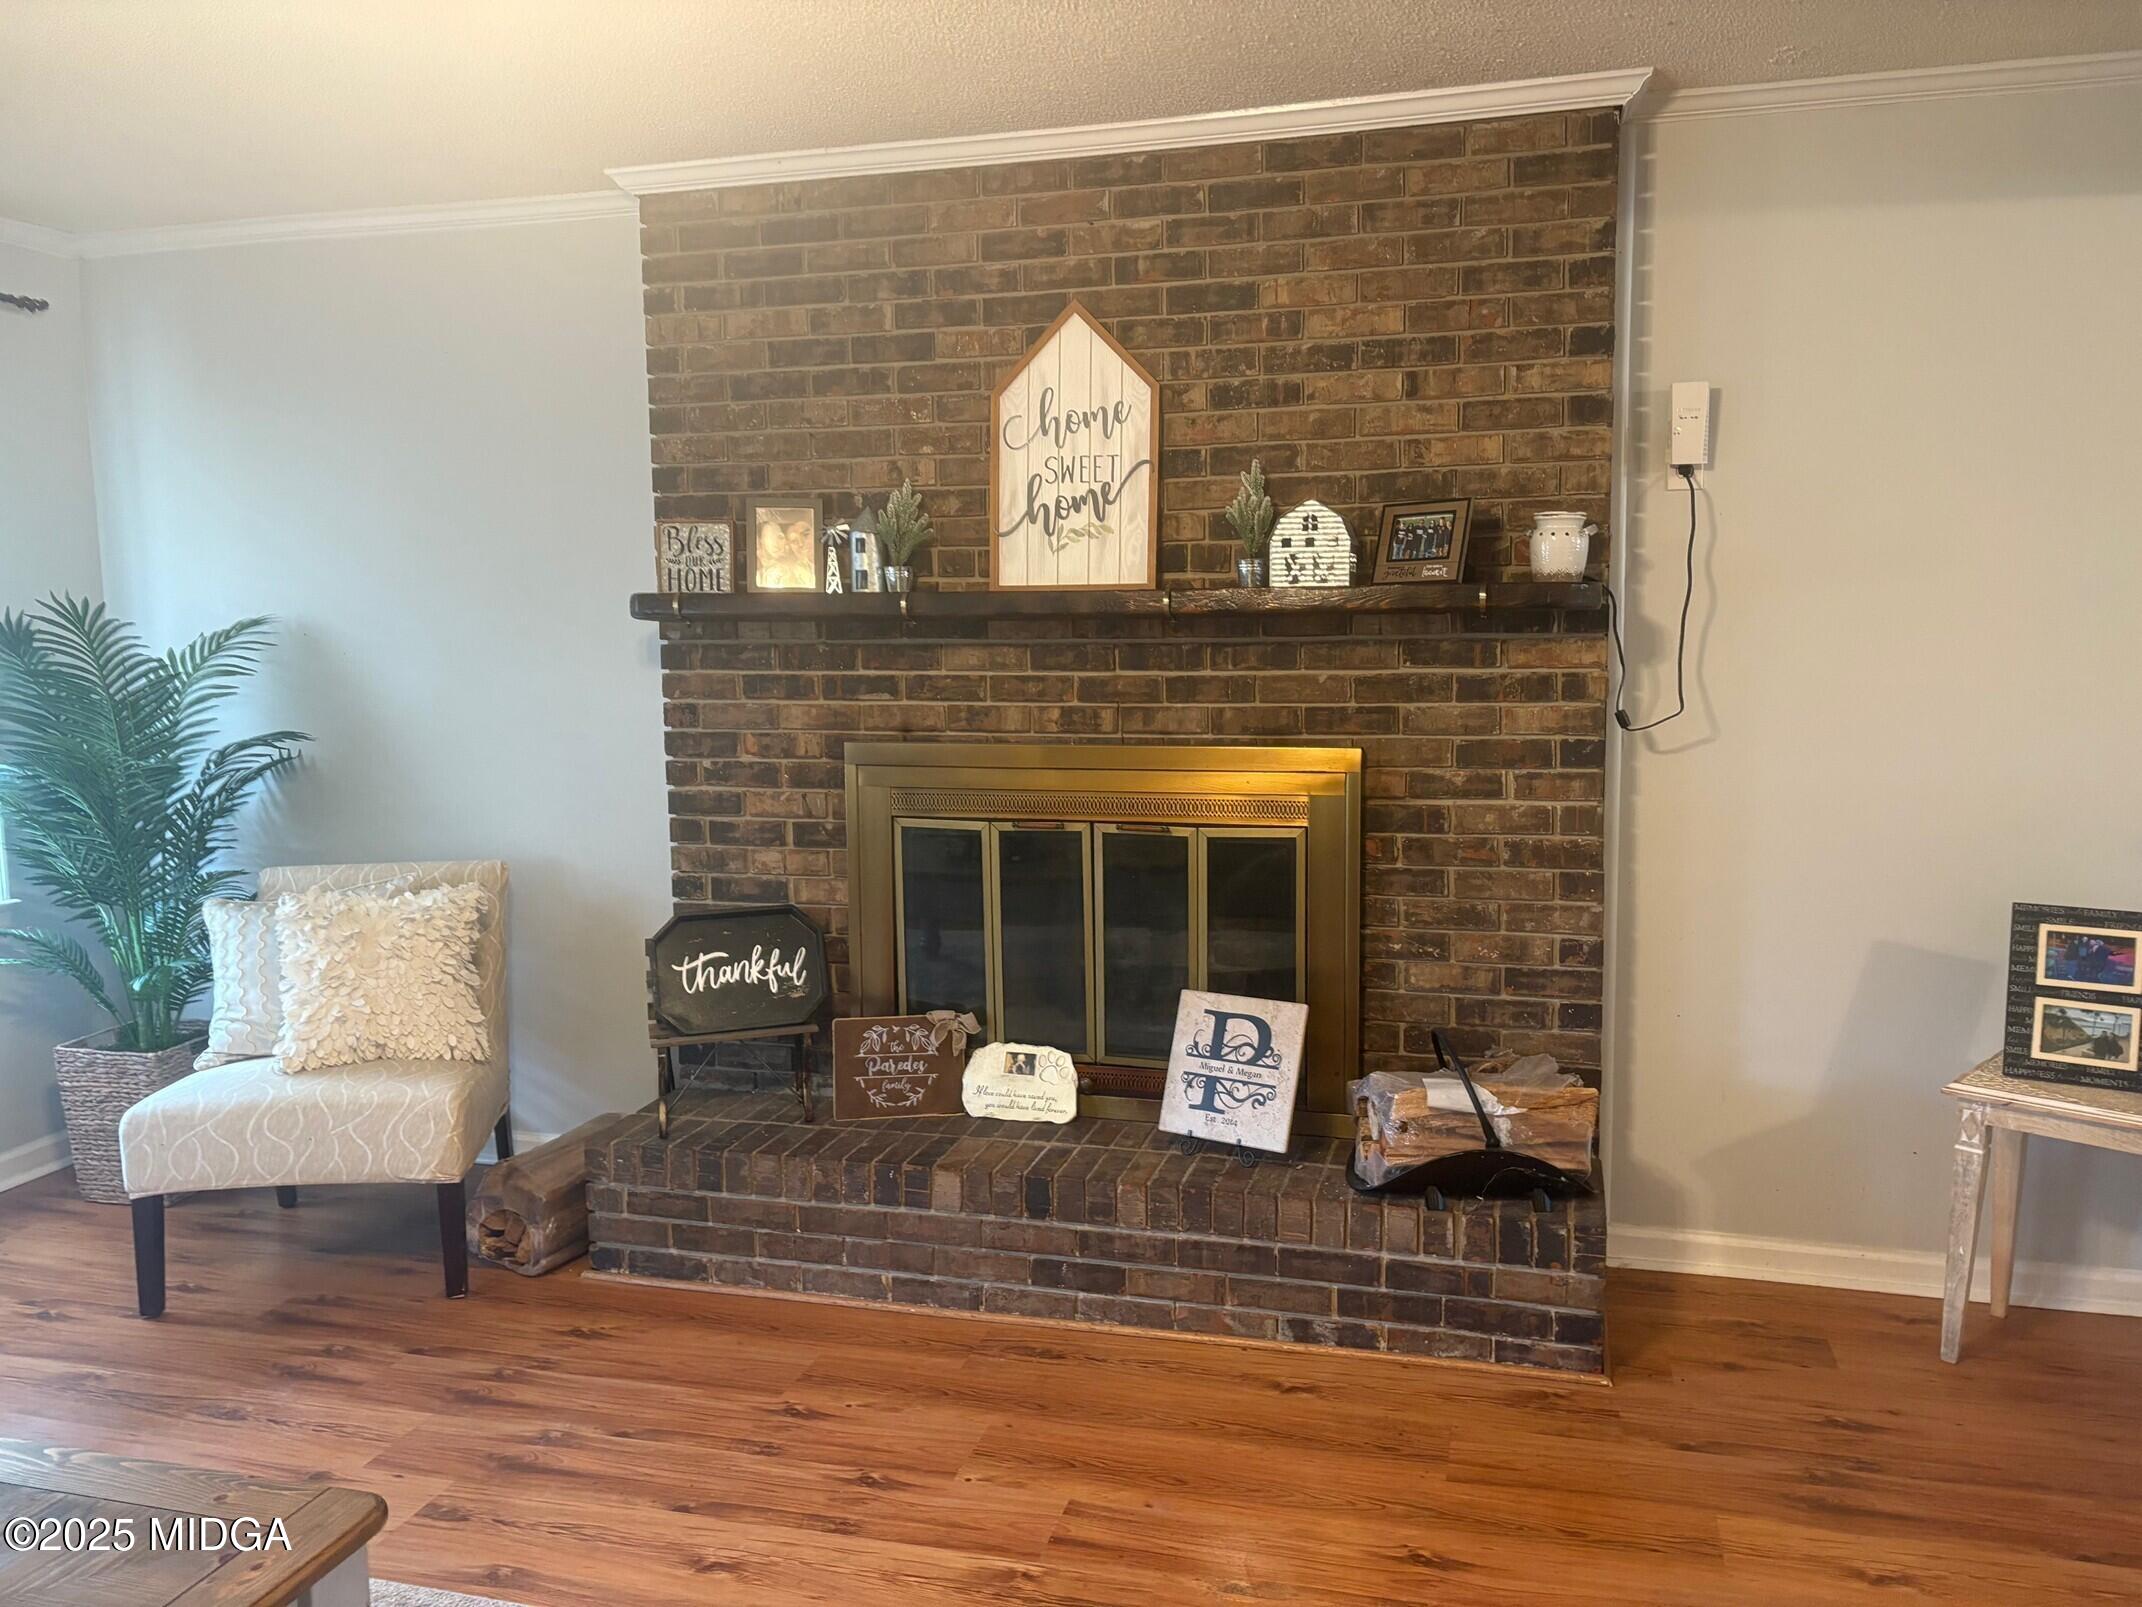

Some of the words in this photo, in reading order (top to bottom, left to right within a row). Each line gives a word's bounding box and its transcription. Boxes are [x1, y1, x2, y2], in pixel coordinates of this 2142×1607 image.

[1003, 386, 1132, 451] home
[1044, 454, 1119, 485] SWEET
[993, 459, 1156, 538] home
[663, 525, 724, 557] Bless
[685, 555, 706, 567] OUR
[667, 567, 725, 592] HOME
[671, 944, 808, 995] thankful
[888, 1039, 905, 1053] the
[865, 1055, 929, 1076] Paredes
[1198, 1061, 1226, 1074] Miguel
[1227, 1066, 1234, 1075] &
[1235, 1067, 1263, 1080] Megan
[881, 1077, 912, 1094] family
[972, 1084, 983, 1097] If
[983, 1086, 994, 1096] love
[994, 1088, 1011, 1098] could
[1013, 1089, 1026, 1098] have
[1027, 1091, 1045, 1100] saved
[996, 1100, 1015, 1110] would
[1016, 1101, 1029, 1111] have
[1031, 1101, 1045, 1112] lived
